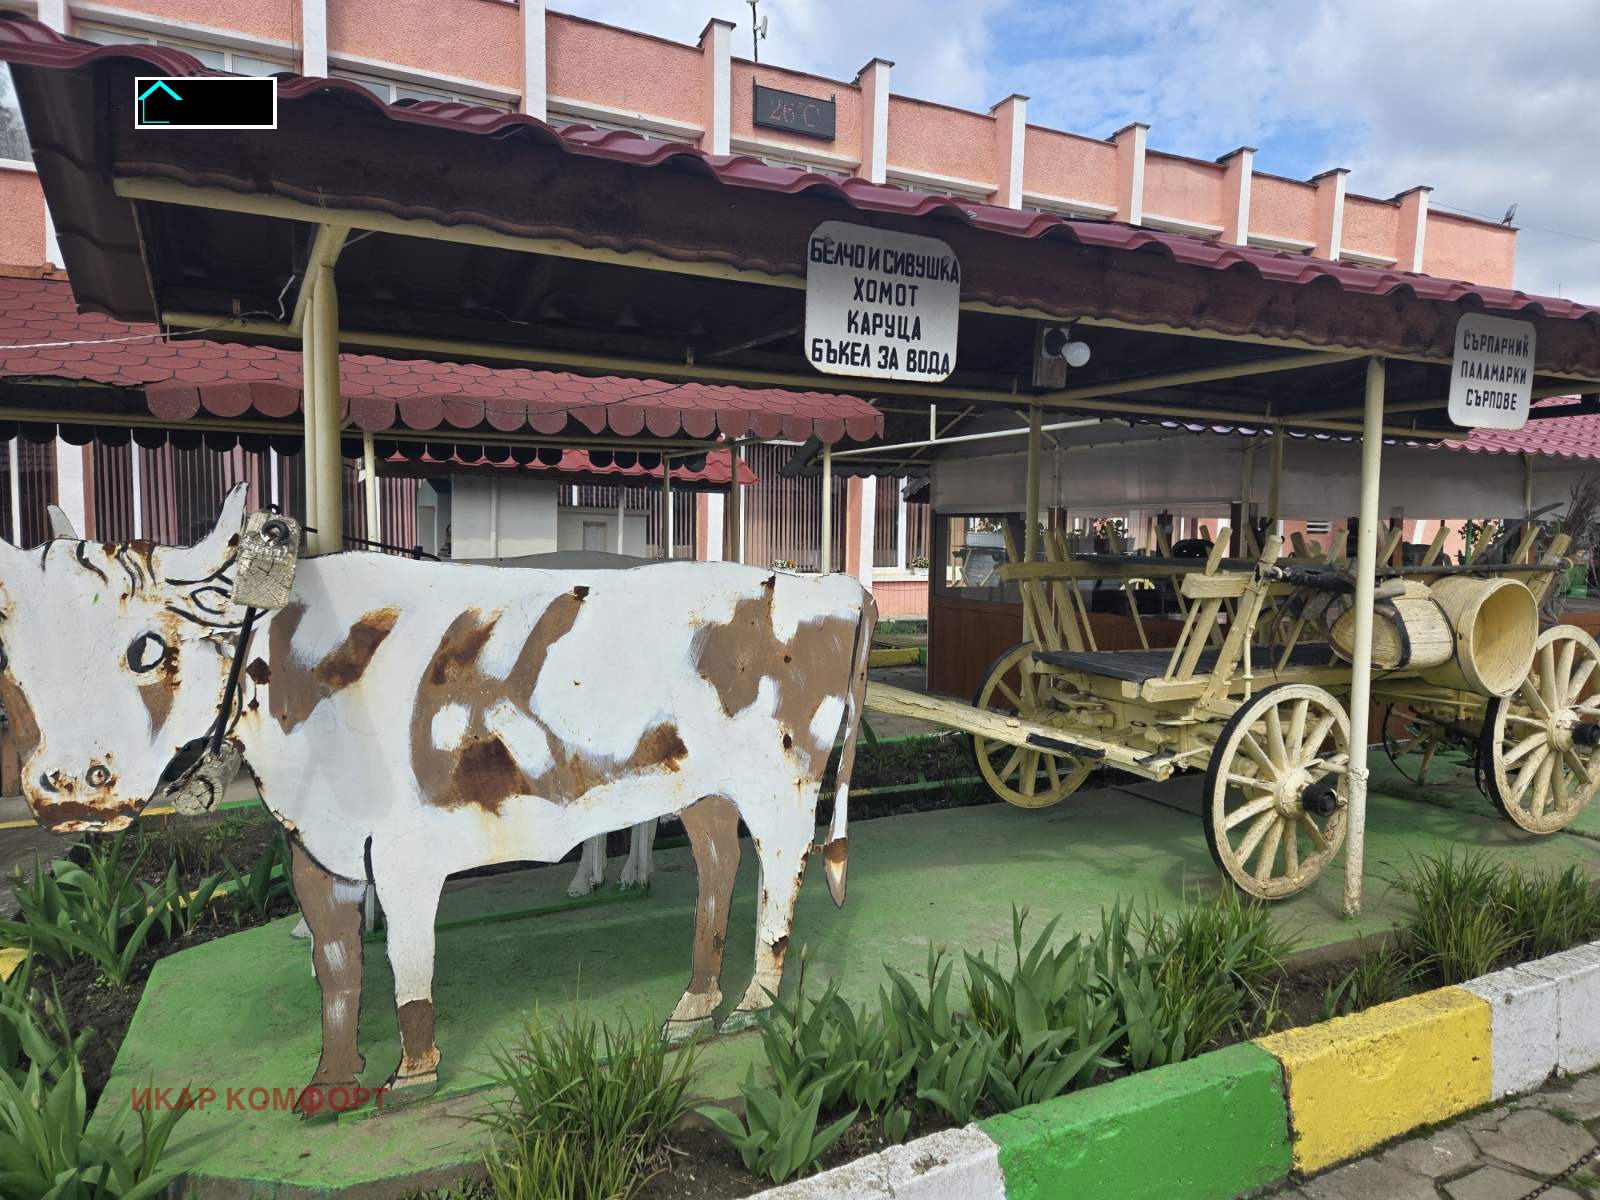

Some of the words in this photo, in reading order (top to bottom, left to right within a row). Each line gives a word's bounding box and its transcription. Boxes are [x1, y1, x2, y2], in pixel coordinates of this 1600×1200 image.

[810, 237, 866, 269] БЕЛЧО
[868, 246, 880, 271] И
[883, 249, 959, 284] СИВУШКА
[853, 276, 919, 307] ХОМОТ
[847, 310, 921, 342] КАРУЦА
[811, 338, 871, 368] БЪКЕЛ
[877, 345, 899, 371] ЗА
[906, 348, 950, 375] ВОДА
[1463, 330, 1529, 358] СЪРПАРНИК
[1460, 360, 1527, 385] ПАЛАМАРКИ
[1465, 388, 1518, 411] СЪРПОВЕ
